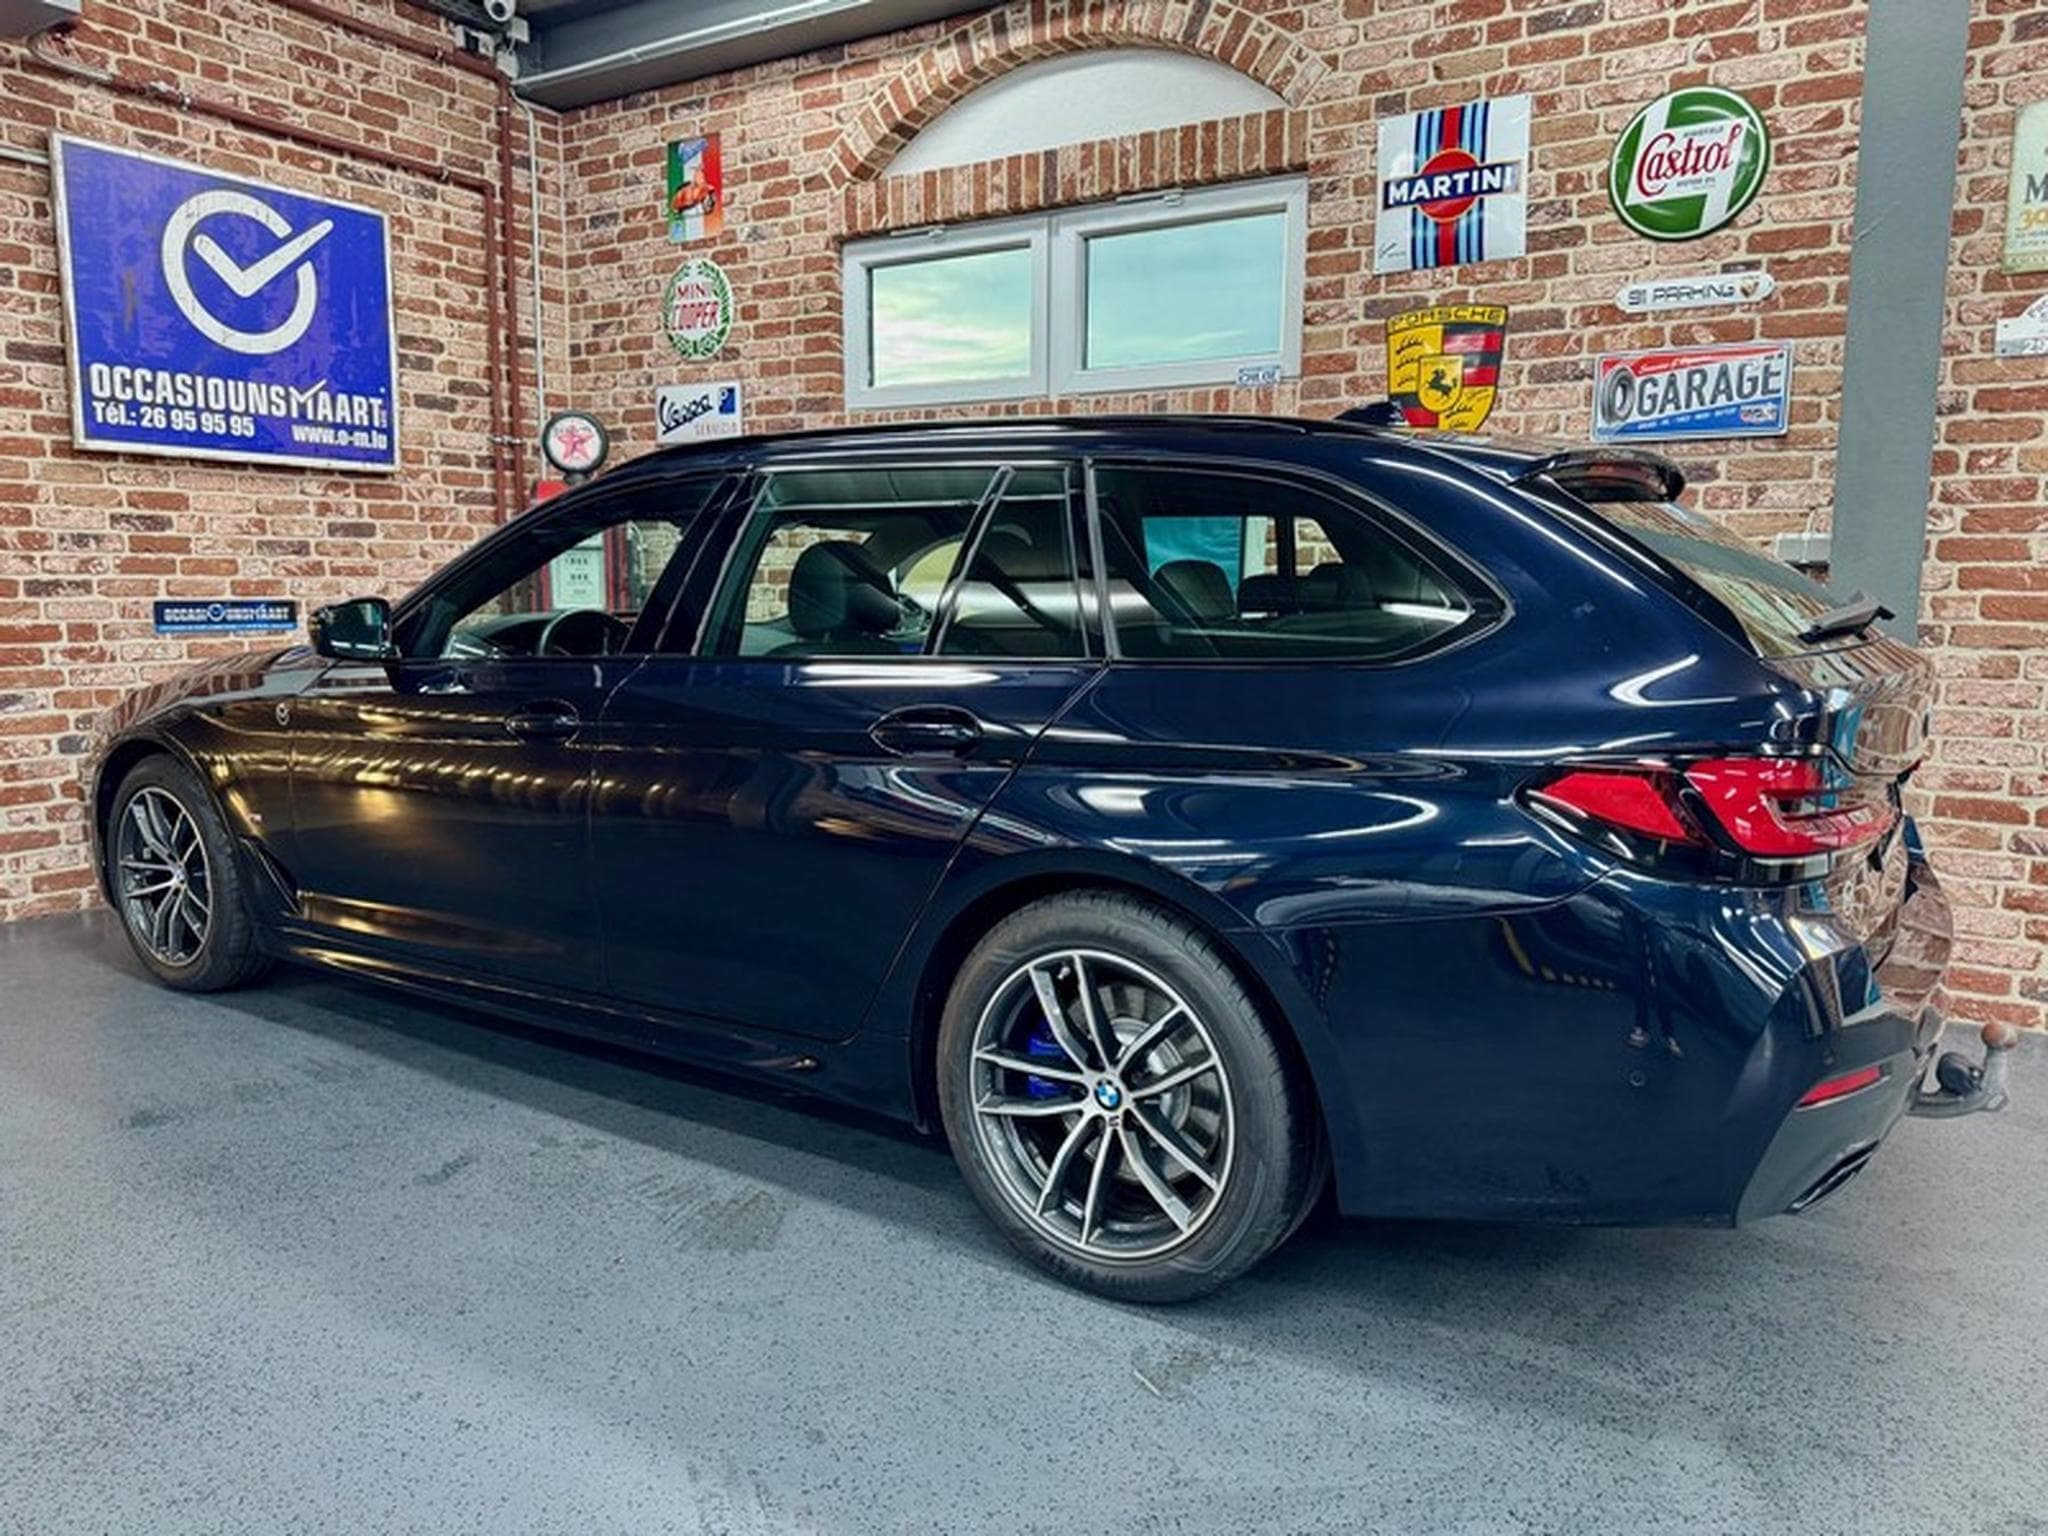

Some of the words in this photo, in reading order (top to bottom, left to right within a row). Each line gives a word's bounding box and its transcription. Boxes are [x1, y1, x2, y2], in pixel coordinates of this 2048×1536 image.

[1637, 123, 1743, 198] Castrol
[1388, 166, 1513, 206] MARTINI
[672, 301, 719, 331] COOPER
[1390, 307, 1502, 331] PORSCHE
[90, 363, 384, 428] OCCASIOUNSMAART
[1636, 362, 1783, 417] GARAGE
[140, 406, 167, 429] 26
[170, 409, 198, 432] 95
[200, 412, 227, 434] 95
[229, 416, 255, 438] 95
[660, 394, 713, 436] Vespa
